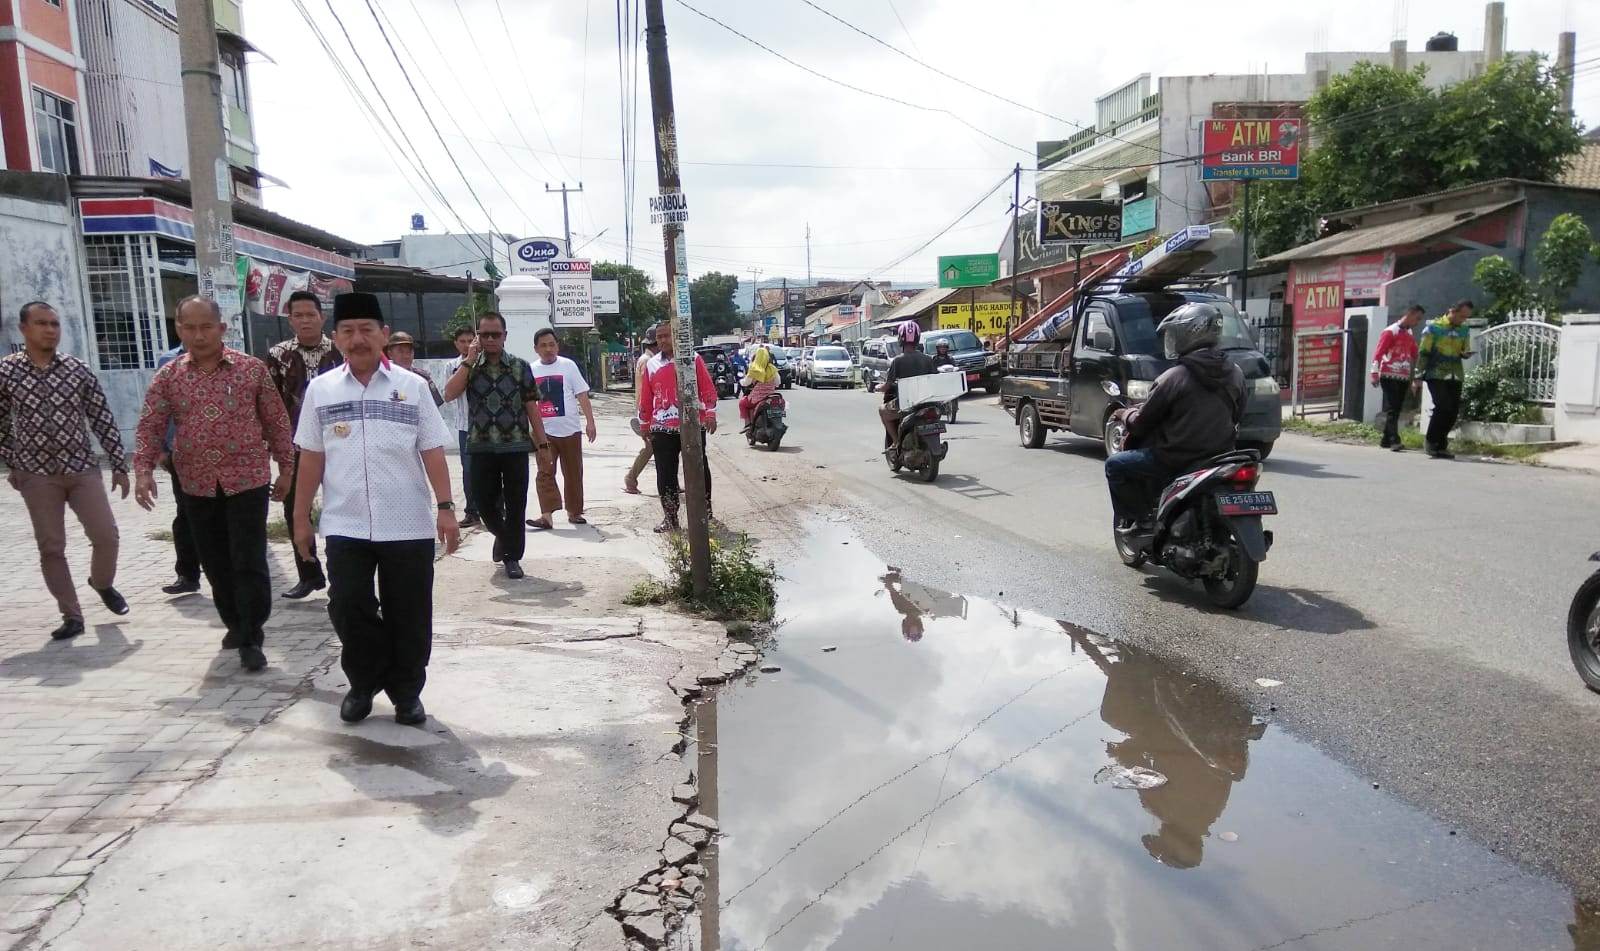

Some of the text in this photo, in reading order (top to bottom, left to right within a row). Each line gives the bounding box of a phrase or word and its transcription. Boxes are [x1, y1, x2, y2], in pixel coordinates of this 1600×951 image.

[1212, 122, 1227, 131] Mr.
[1231, 121, 1271, 146] ATM
[1221, 151, 1281, 162] Bank BRI
[1212, 168, 1242, 176] Transfer
[649, 194, 688, 212] PARABOLA
[1046, 212, 1121, 239] KING'S
[677, 276, 688, 289] WC
[679, 290, 690, 315] SEDOT
[1305, 286, 1340, 309] ATM
